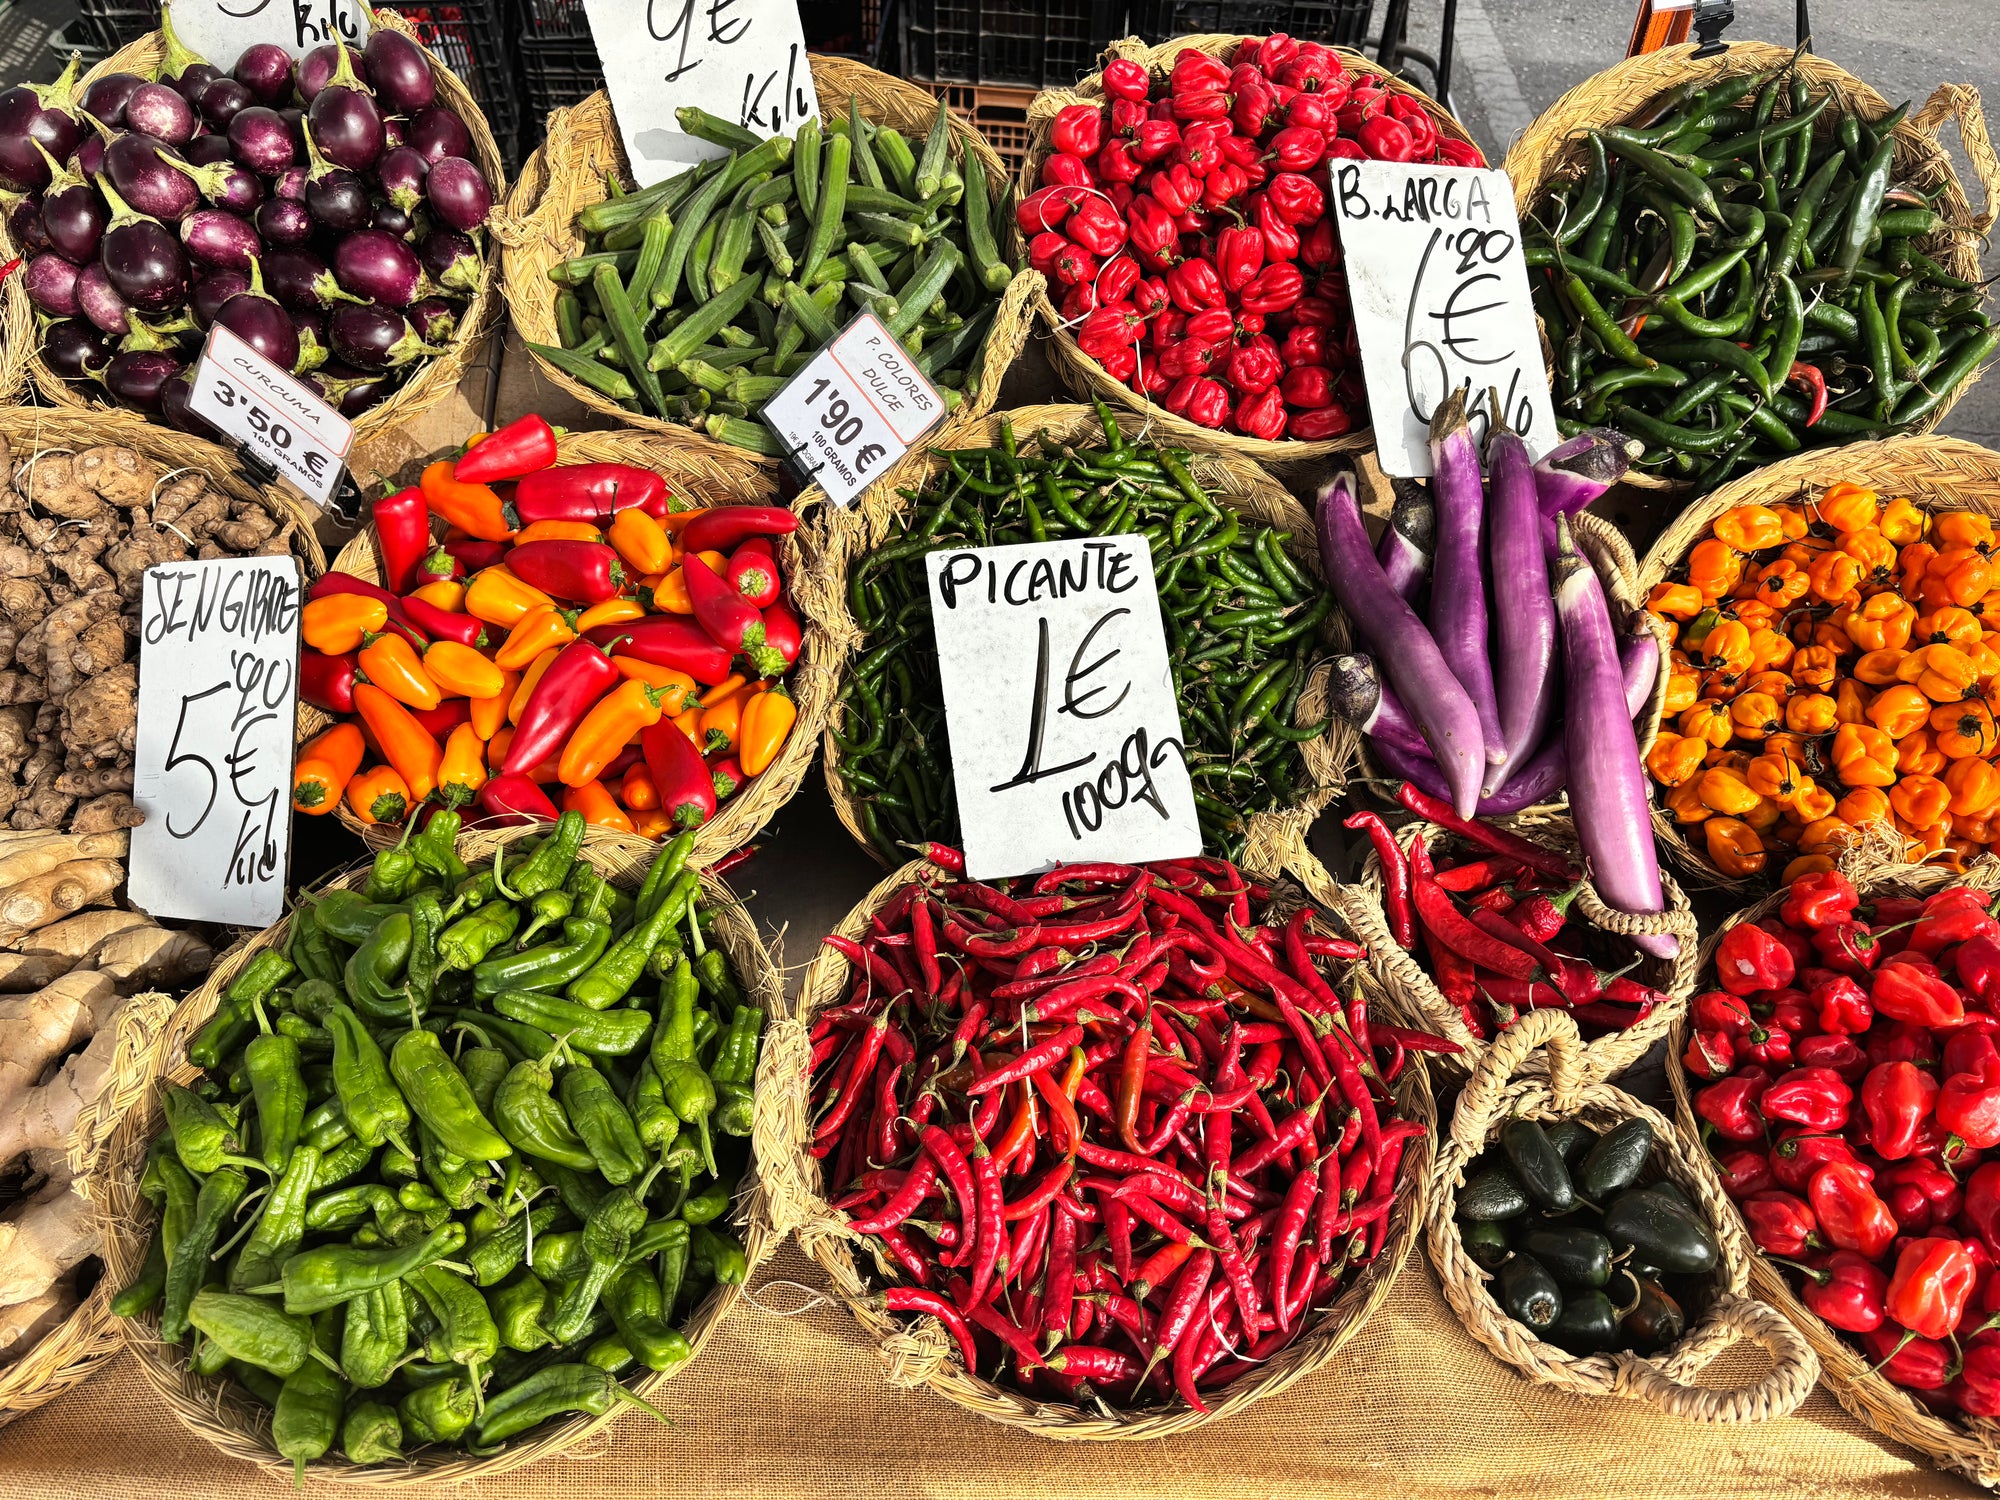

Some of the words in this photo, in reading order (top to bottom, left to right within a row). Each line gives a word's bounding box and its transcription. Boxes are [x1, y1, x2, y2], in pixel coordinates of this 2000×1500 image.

[233, 357, 322, 425] CURCUMA
[862, 367, 904, 412] DULCE
[878, 352, 933, 411] COLORES
[213, 380, 292, 449] 3'50
[302, 451, 329, 478] €
[804, 378, 864, 446] 1'90
[855, 443, 887, 474] €
[252, 431, 271, 448] 100
[274, 448, 323, 489] GRAMOS
[796, 440, 823, 474] KOGRAO
[812, 430, 827, 448] 100
[823, 446, 857, 487] GRAMOS
[939, 543, 1138, 609] PICANTE
